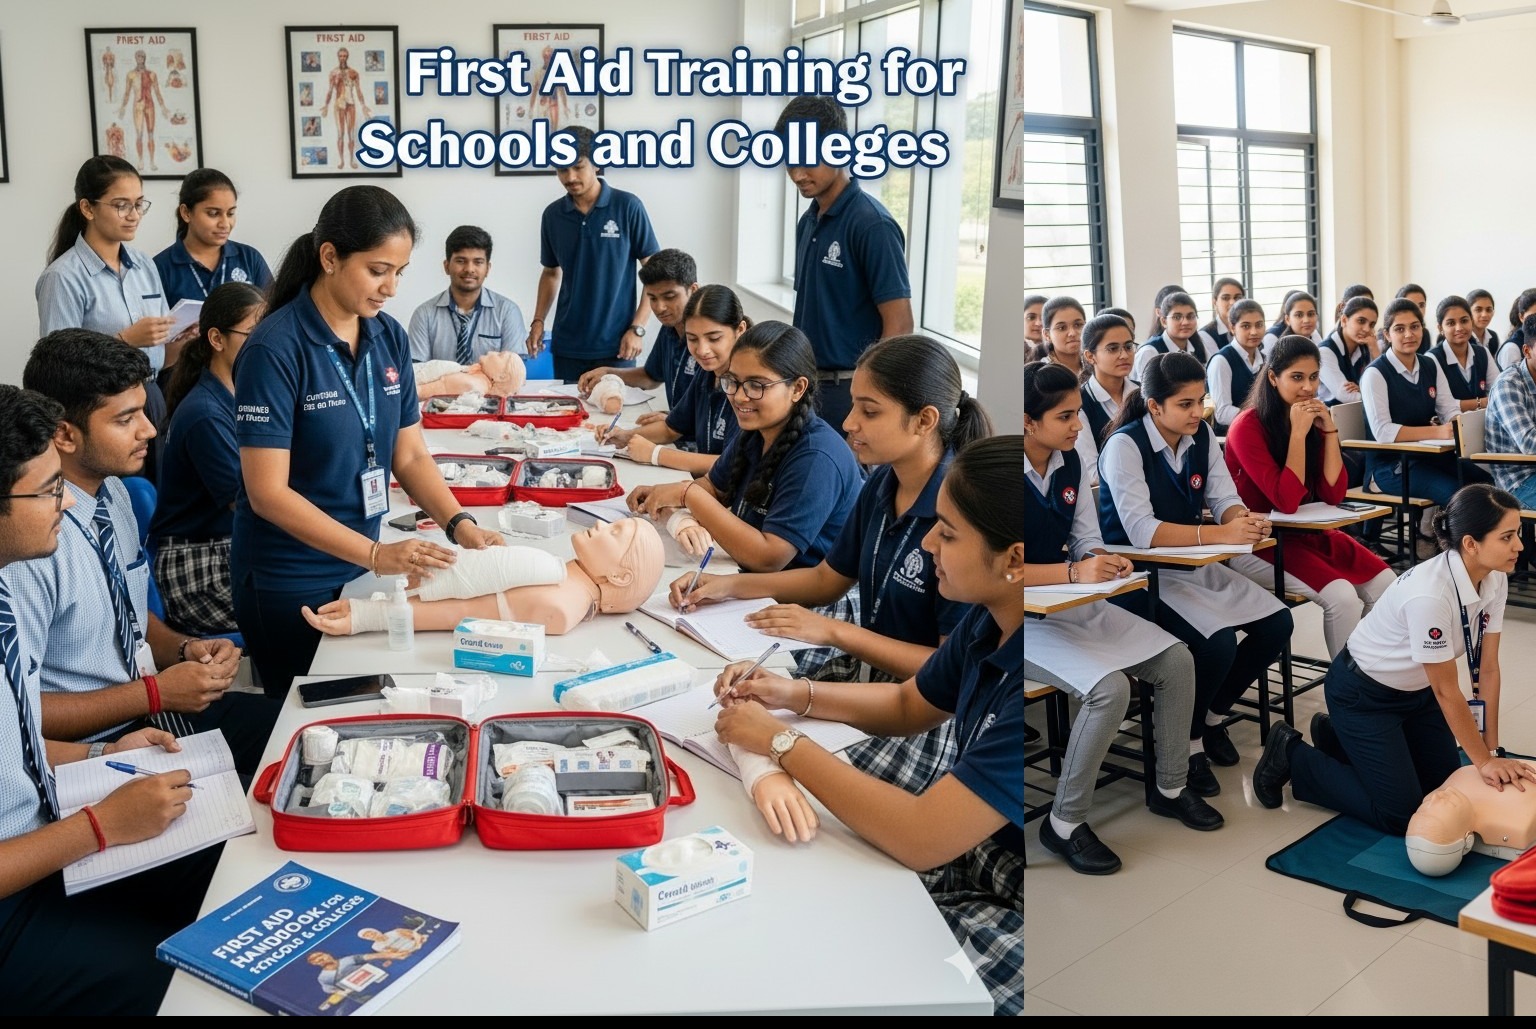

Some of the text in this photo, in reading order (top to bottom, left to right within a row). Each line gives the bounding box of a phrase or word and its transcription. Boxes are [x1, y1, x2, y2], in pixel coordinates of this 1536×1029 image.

[148, 35, 166, 45] AID
[348, 33, 366, 43] AID
[554, 32, 570, 41] AID
[212, 926, 264, 959] FIRST
[261, 908, 295, 930] AID
